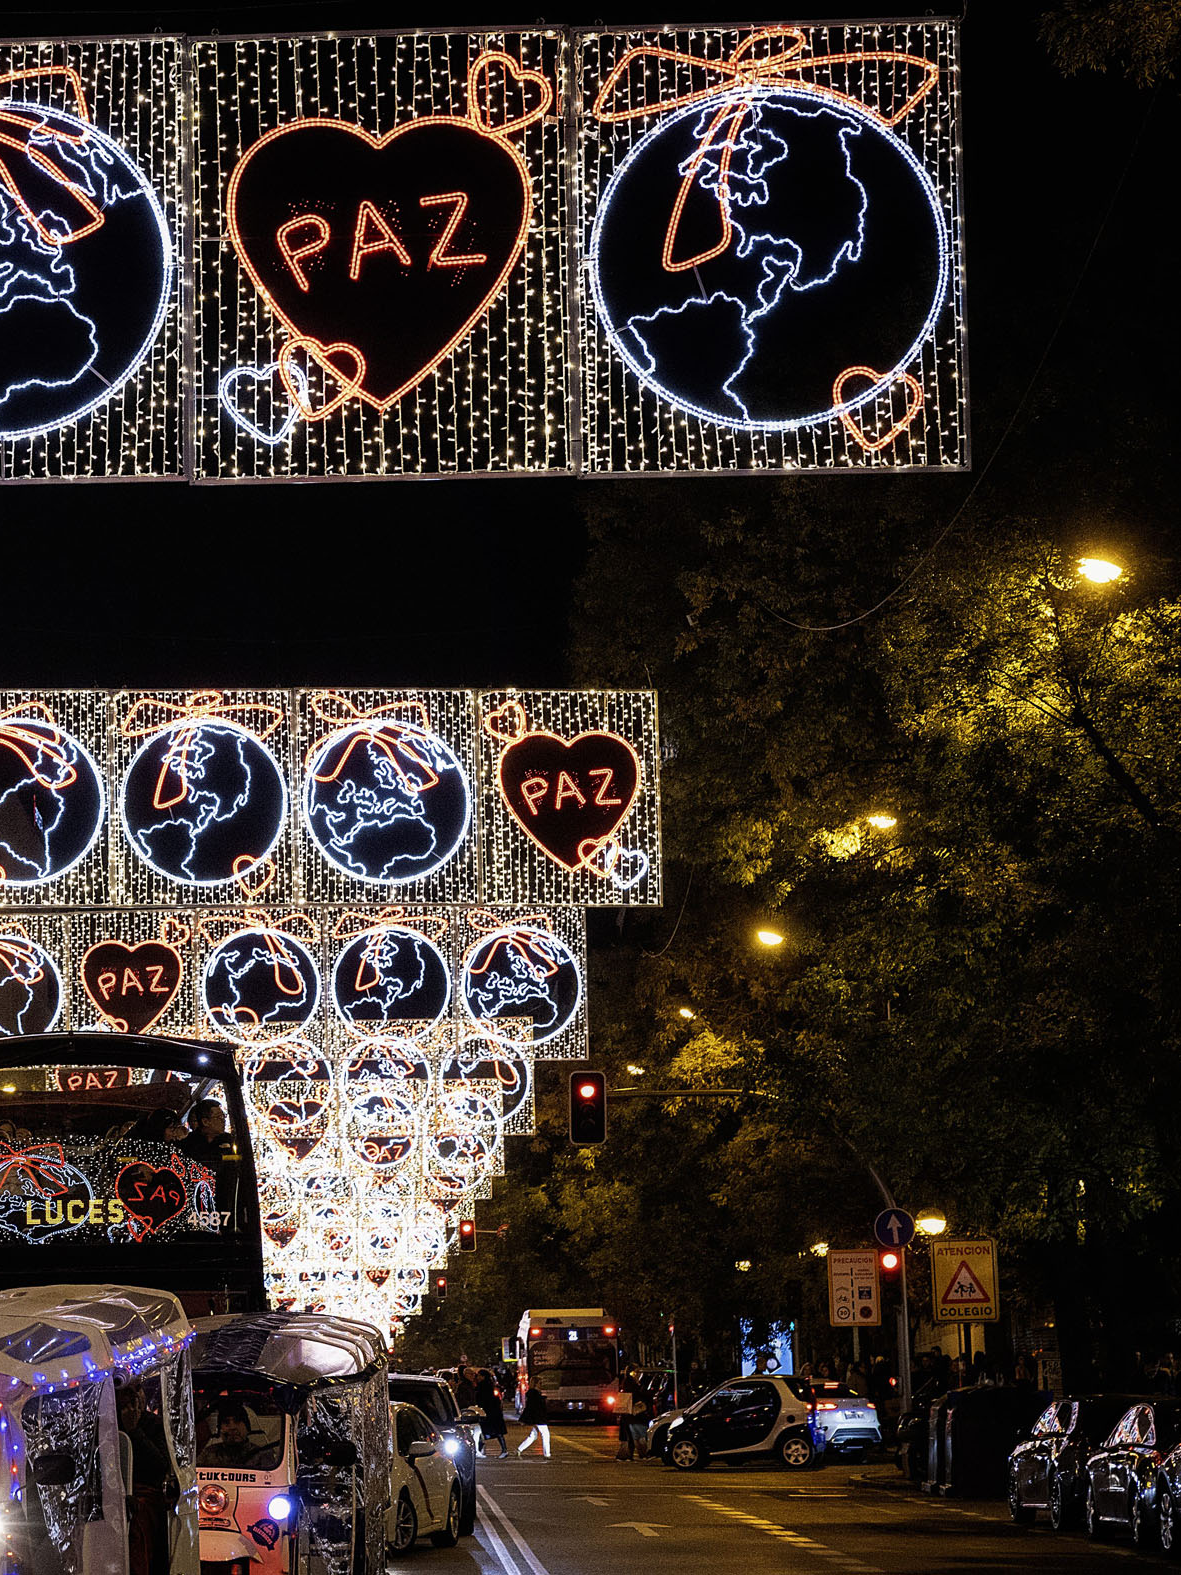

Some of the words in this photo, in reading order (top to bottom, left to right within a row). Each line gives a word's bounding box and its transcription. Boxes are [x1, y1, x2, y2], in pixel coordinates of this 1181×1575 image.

[276, 191, 487, 292] PAZ
[521, 768, 621, 815] PAZ
[97, 965, 170, 1001] PAZ
[26, 1199, 125, 1225] LUCES
[187, 1211, 231, 1227] 4587
[940, 1306, 993, 1317] COLEGIO
